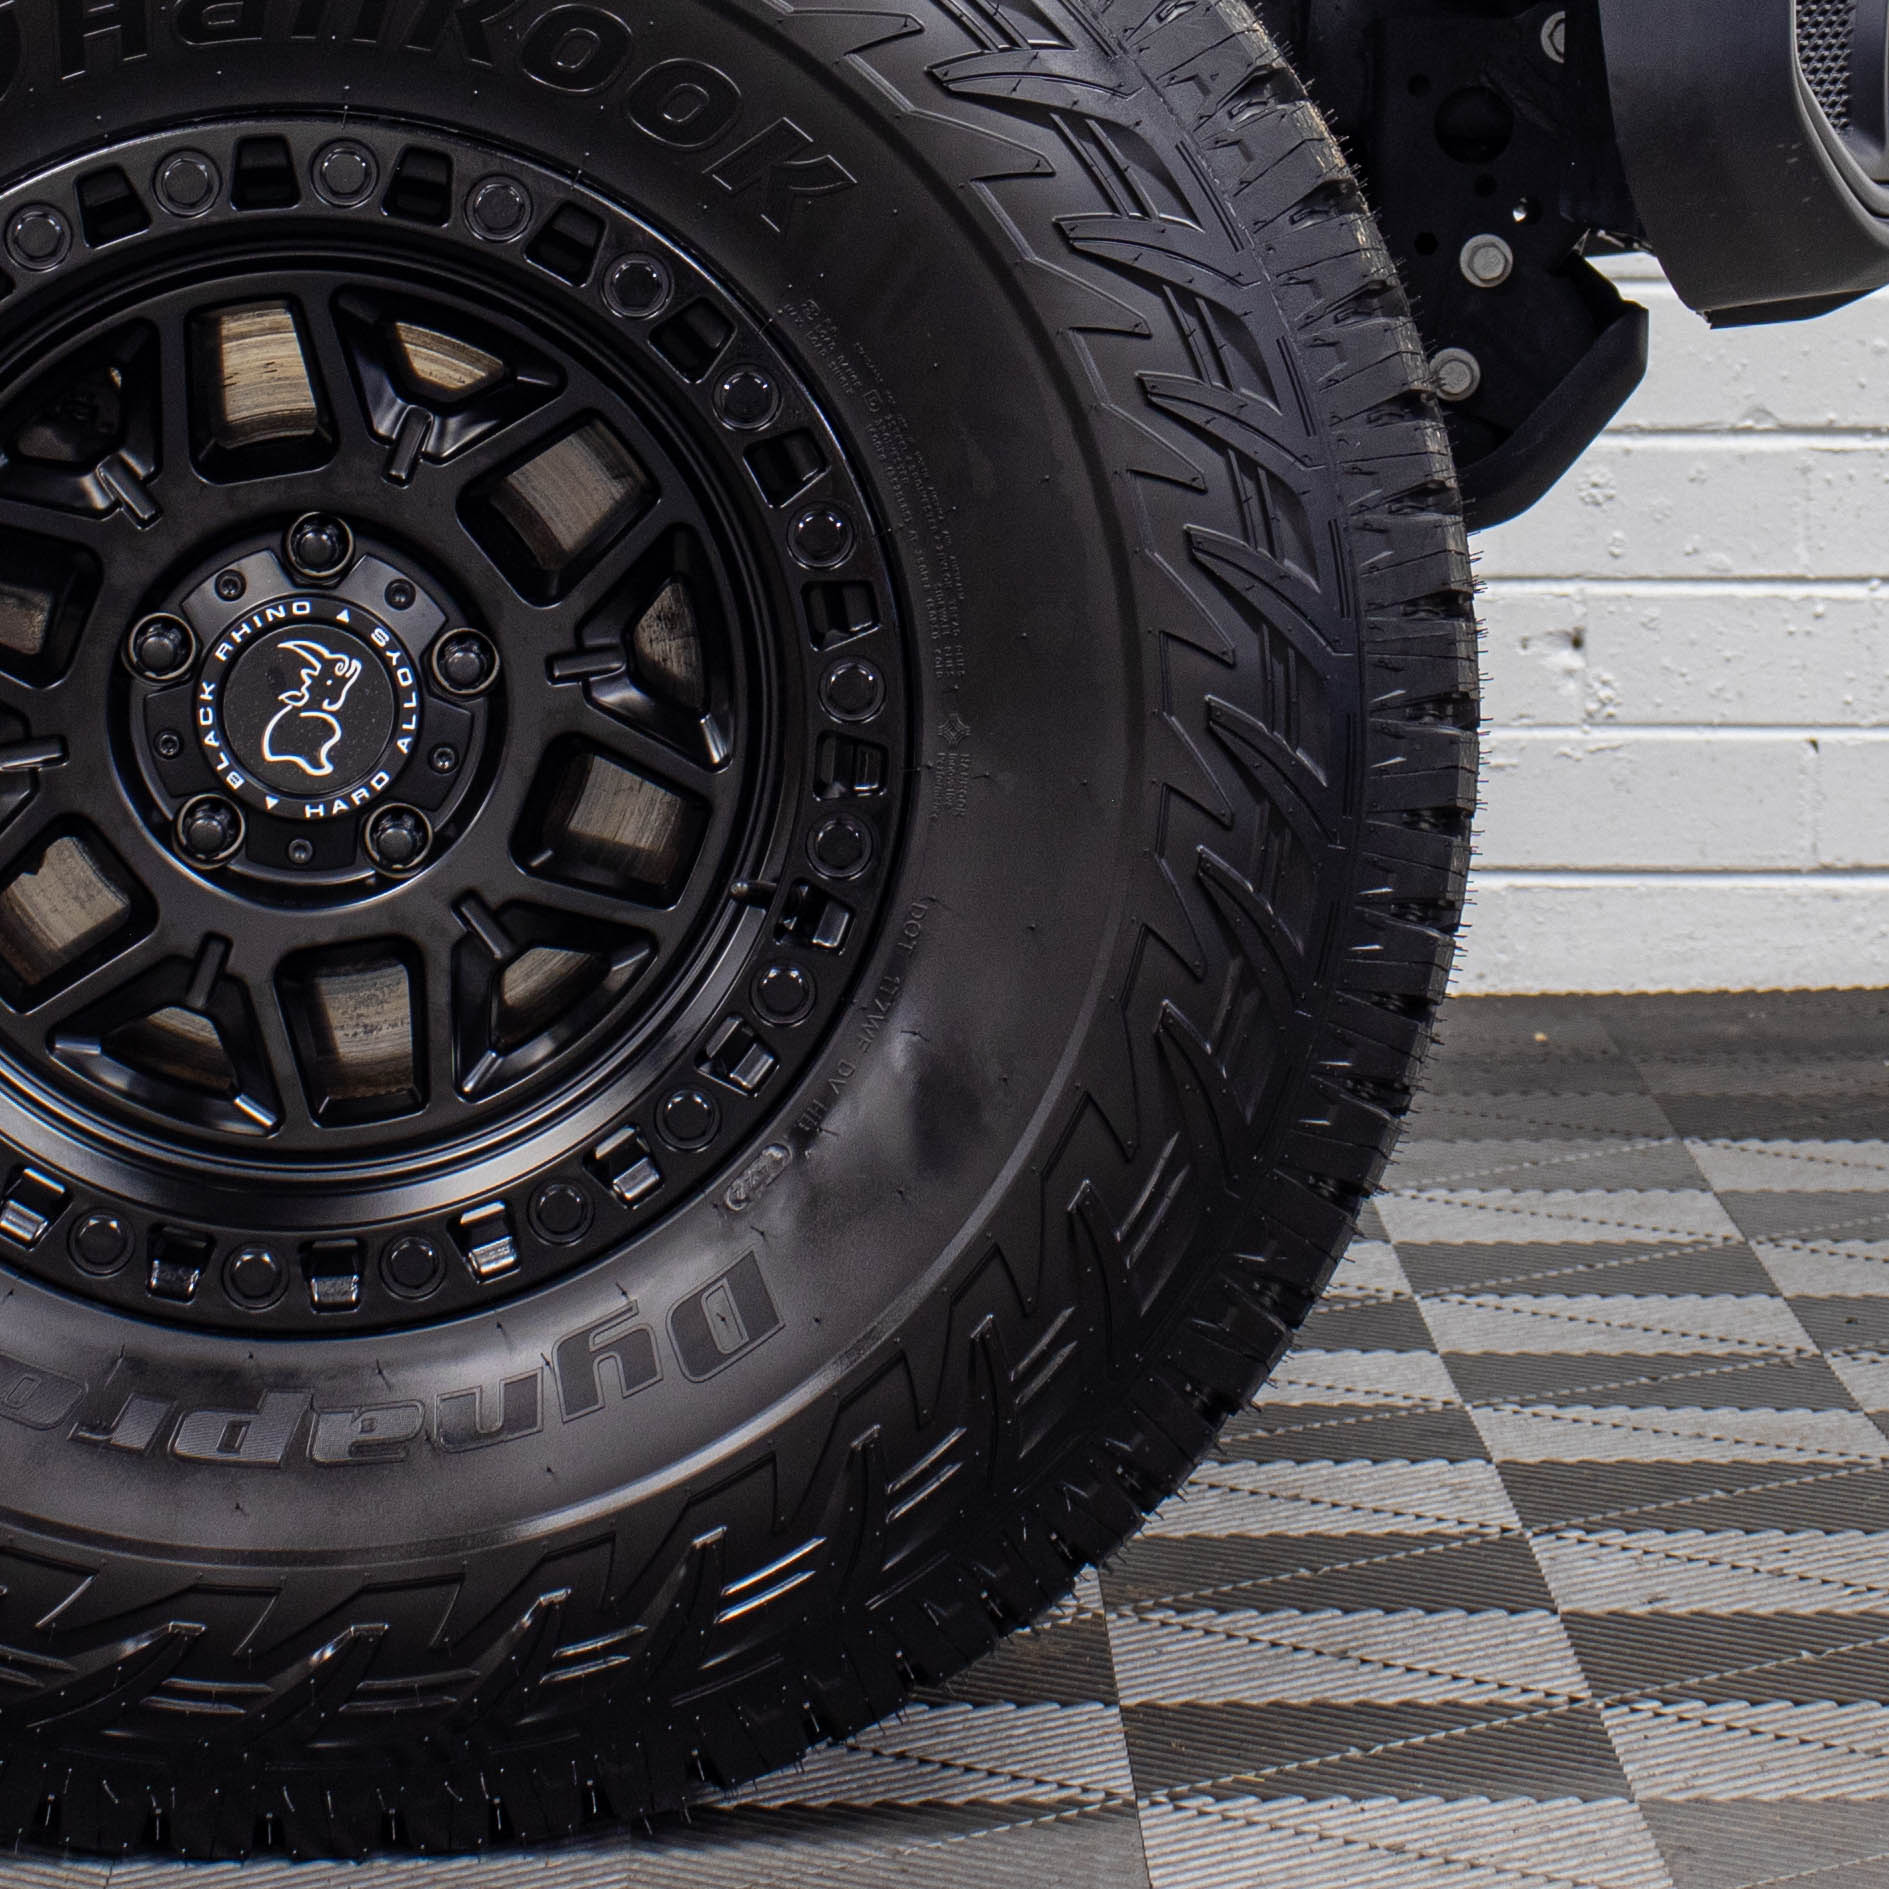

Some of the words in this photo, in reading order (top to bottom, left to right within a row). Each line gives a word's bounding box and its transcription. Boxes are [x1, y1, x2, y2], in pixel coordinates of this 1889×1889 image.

[214, 600, 311, 662] RHINO
[198, 681, 245, 790] BLACK
[303, 770, 390, 819] HARD
[369, 627, 418, 754] ALLOYS
[894, 900, 929, 957] DOT
[823, 1056, 857, 1095] DV
